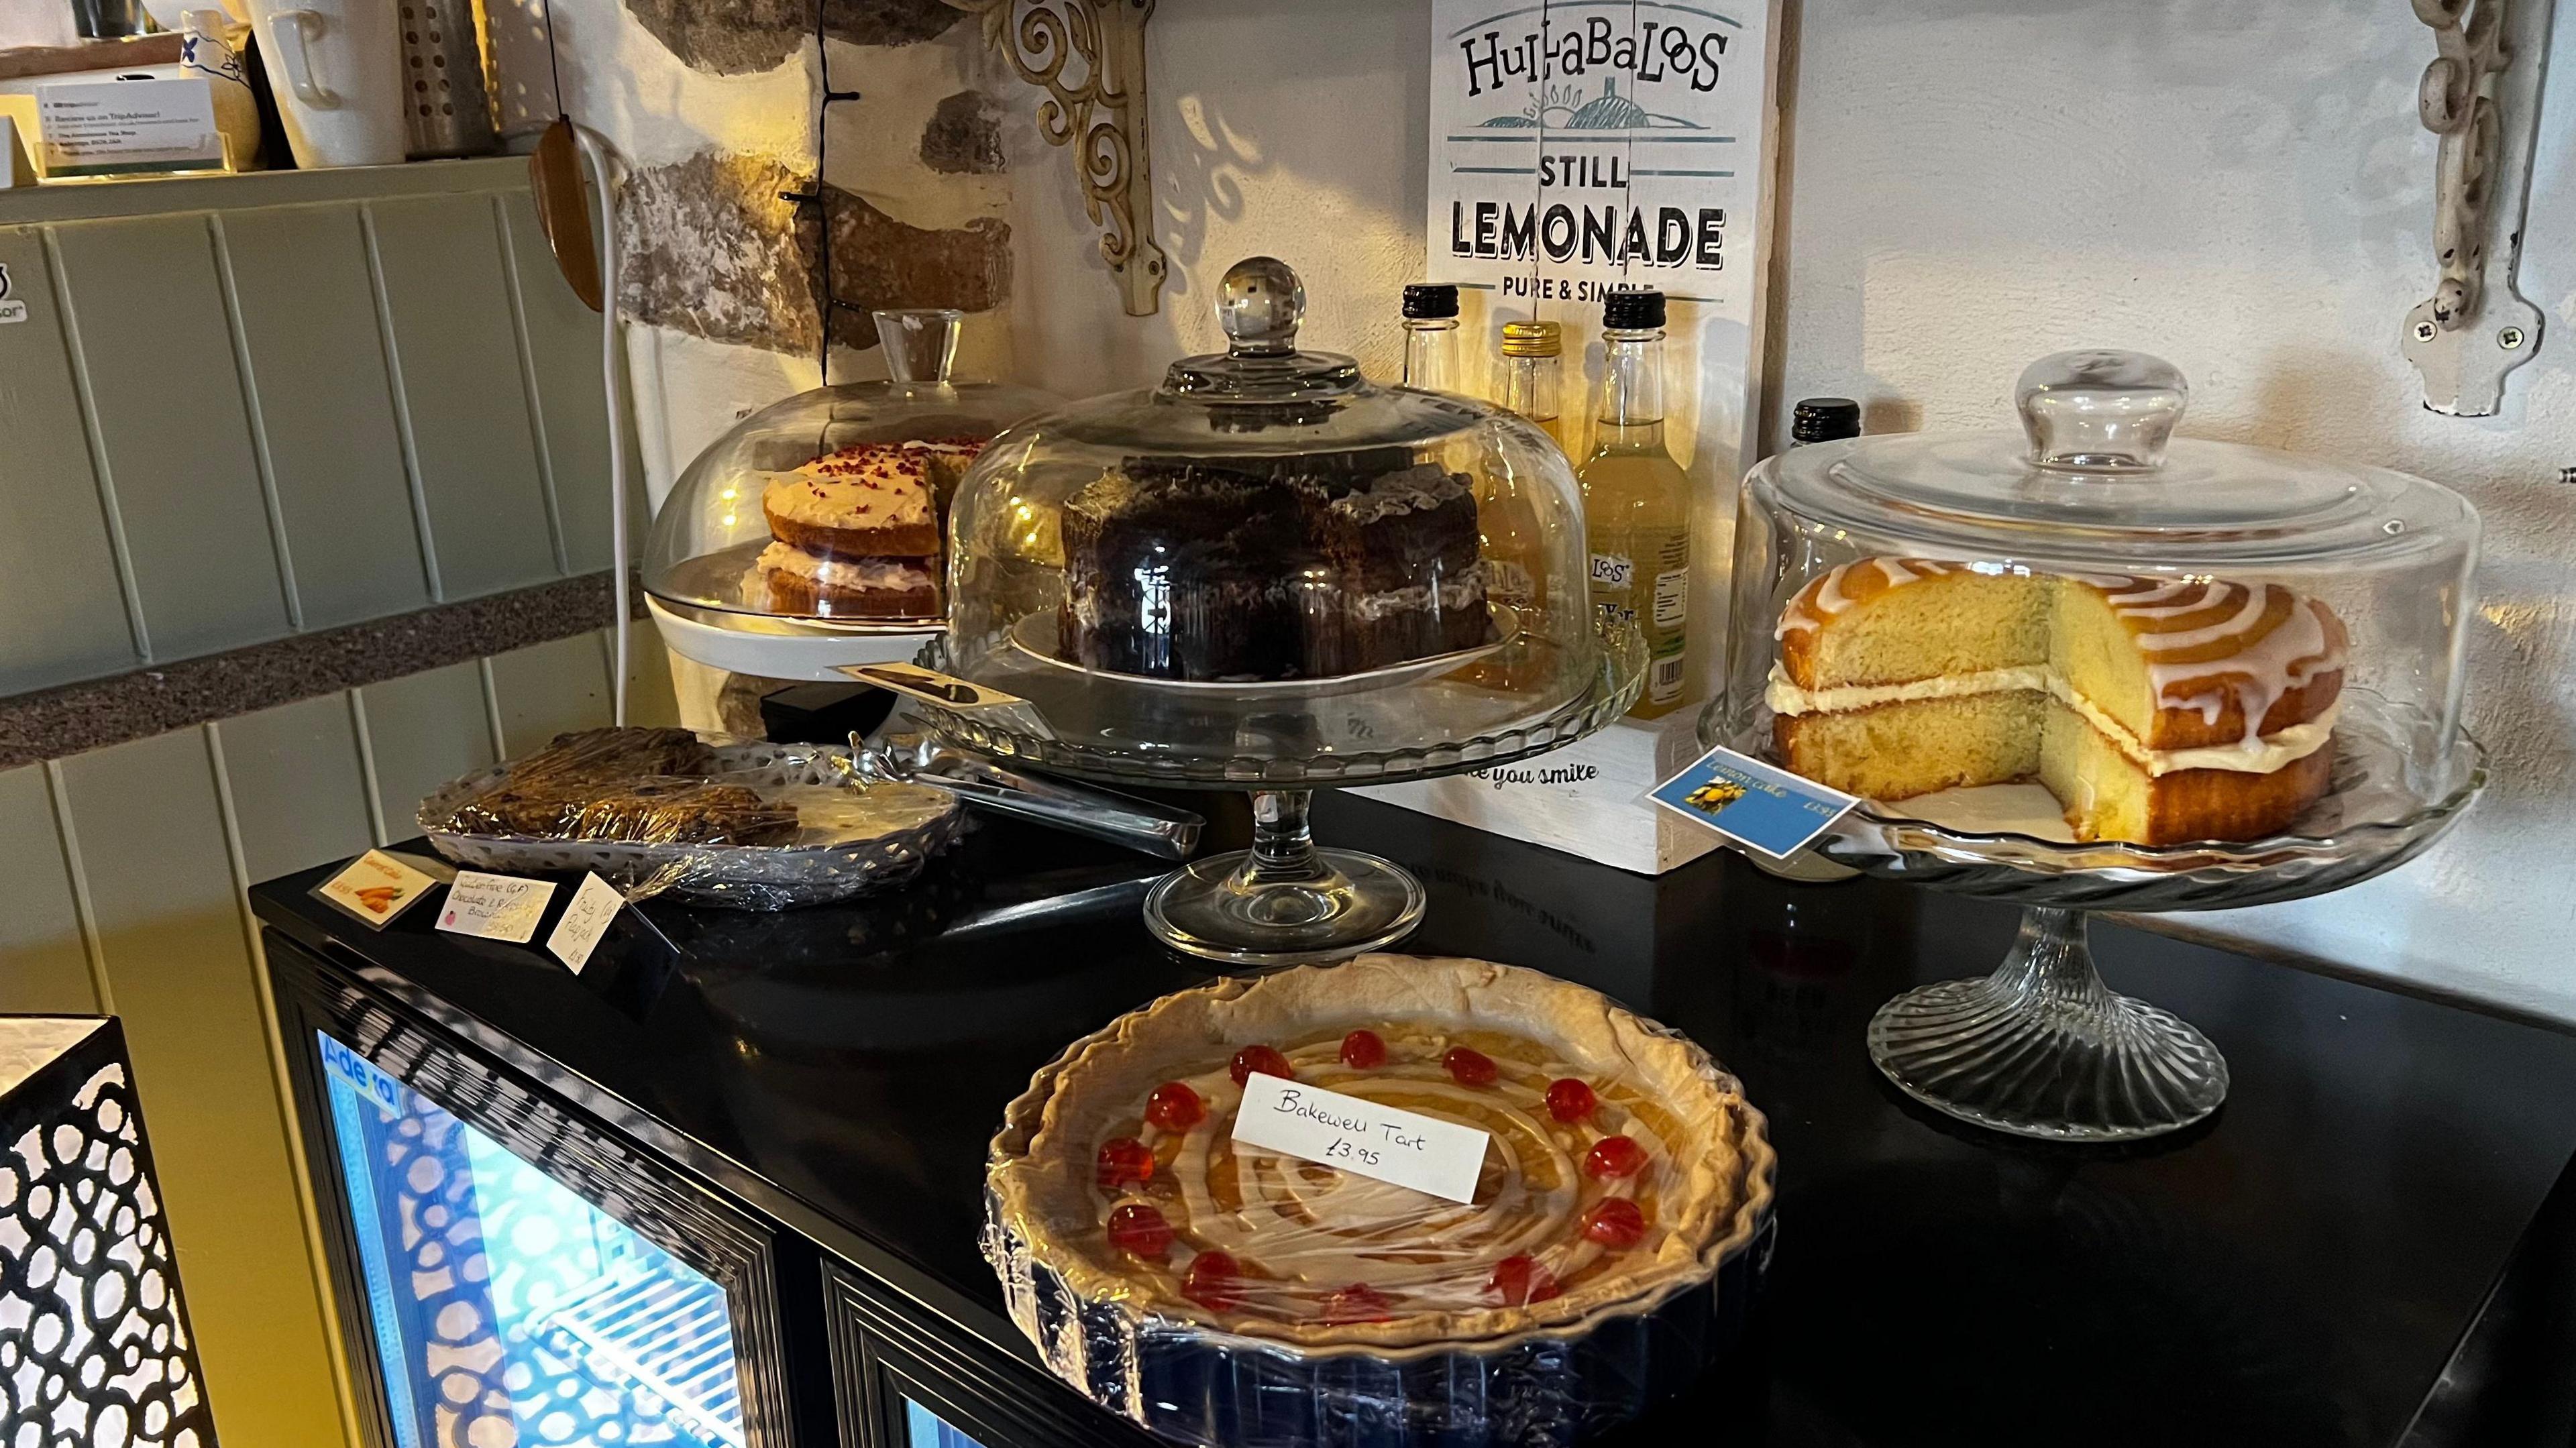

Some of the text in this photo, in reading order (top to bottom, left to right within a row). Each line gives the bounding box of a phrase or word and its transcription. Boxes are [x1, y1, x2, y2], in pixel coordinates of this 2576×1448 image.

[1541, 156, 1627, 188] STILL
[1451, 201, 1726, 270] LEMONADE
[1503, 276, 1554, 299] PURE
[1558, 279, 1572, 300] &
[1493, 767, 1534, 790] you
[1538, 763, 1599, 784] smile
[325, 1036, 395, 1106] Adea
[1273, 1089, 1426, 1152] Bakewell Tart
[1326, 1137, 1380, 1166] £3.95
